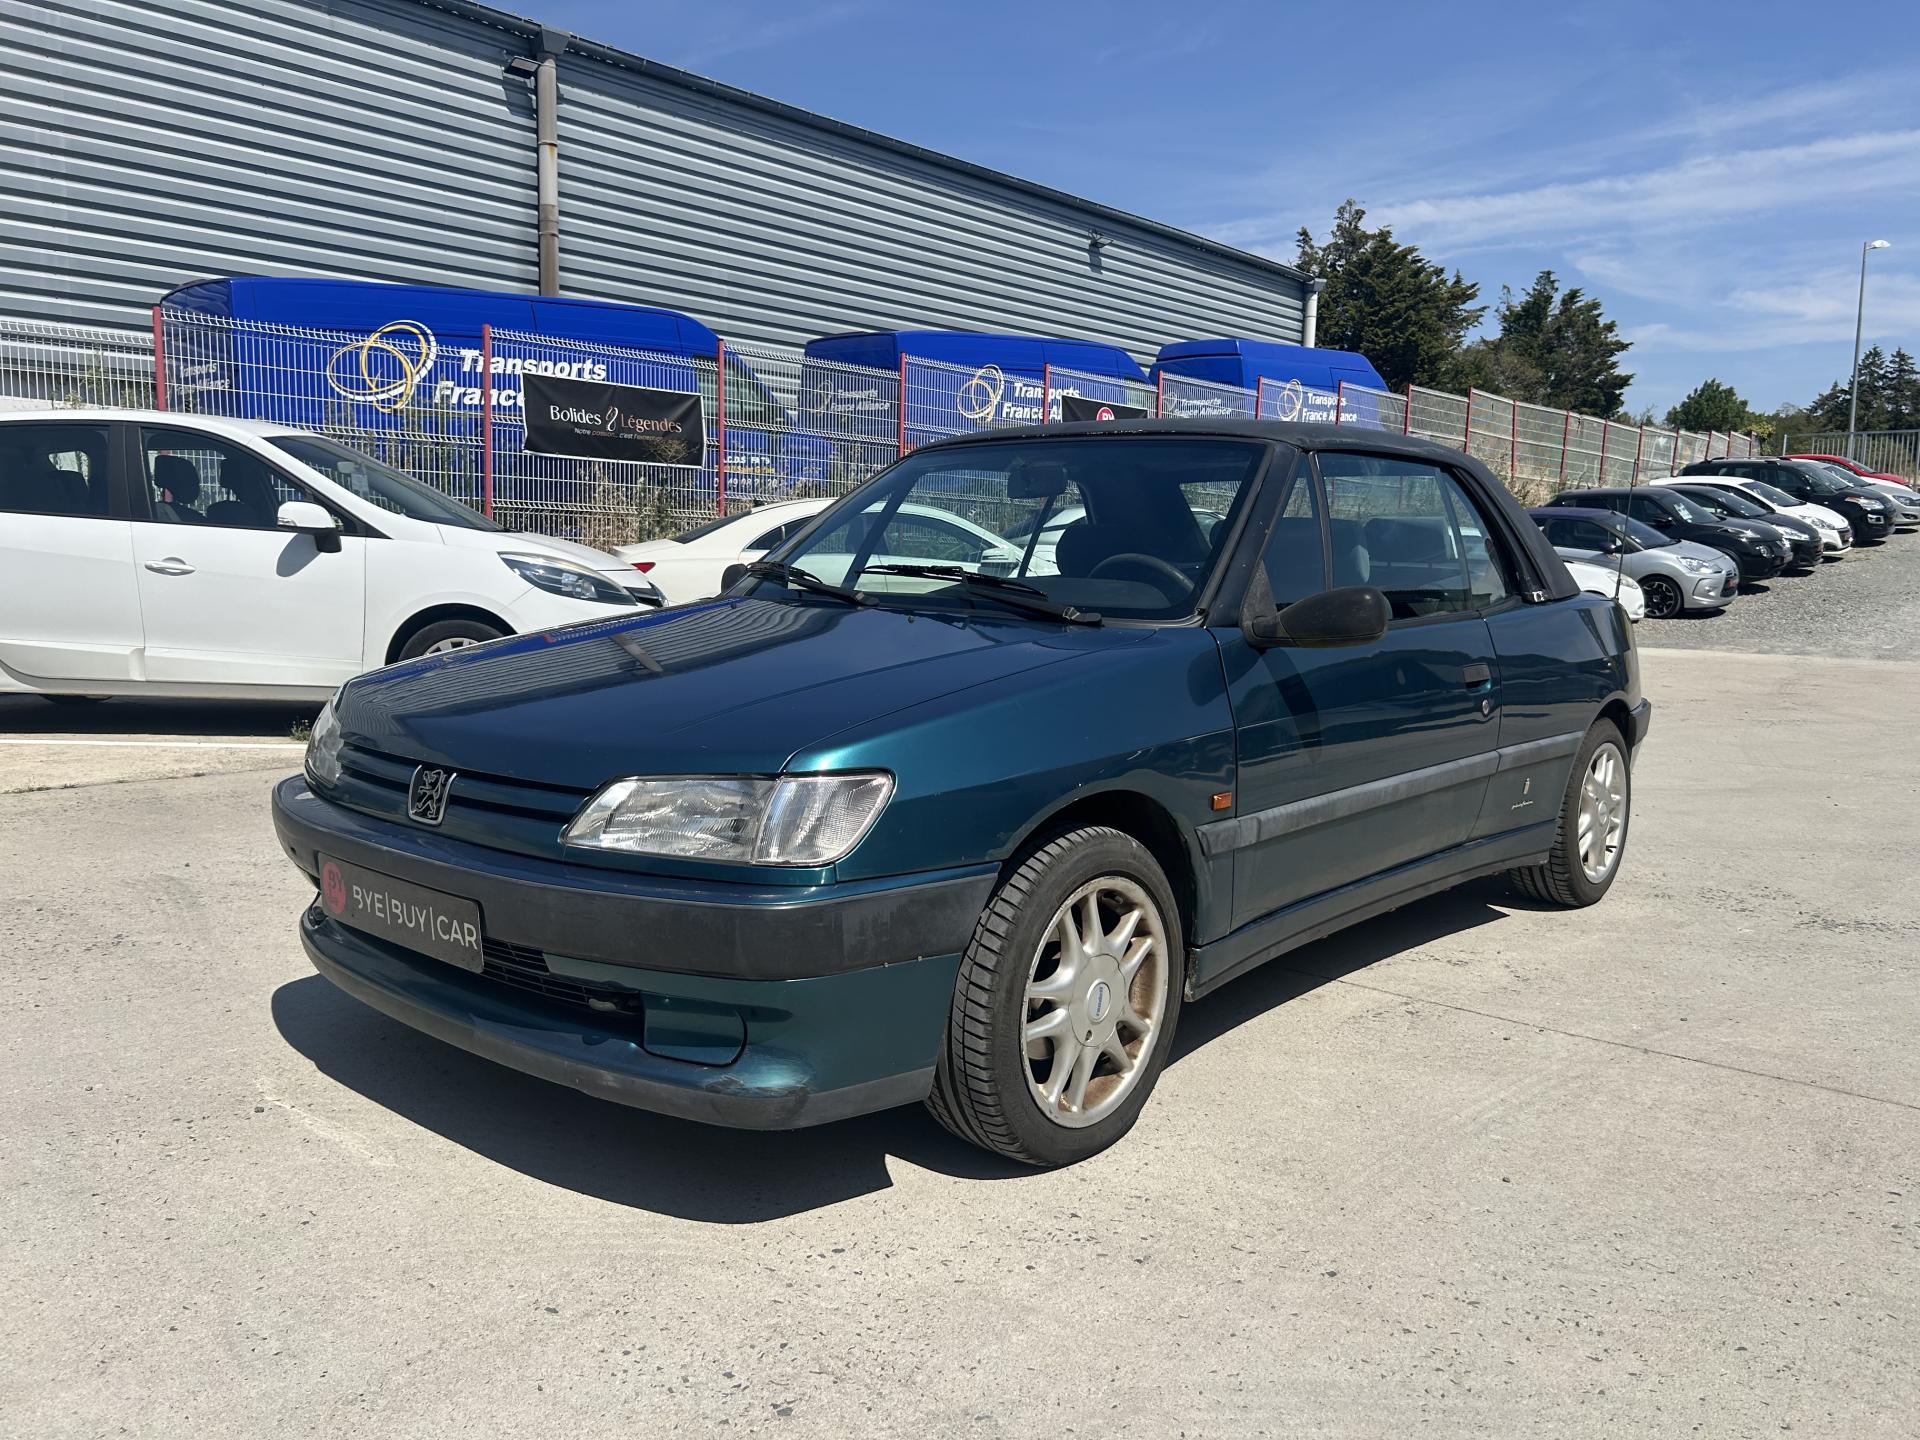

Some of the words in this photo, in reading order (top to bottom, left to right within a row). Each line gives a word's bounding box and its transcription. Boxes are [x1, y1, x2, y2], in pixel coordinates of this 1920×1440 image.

[460, 350, 607, 380] Transports
[550, 405, 601, 425] Bolides
[621, 414, 682, 432] Légendes
[1302, 408, 1327, 422] France
[1329, 409, 1357, 421] Alance
[574, 427, 591, 435] Notre
